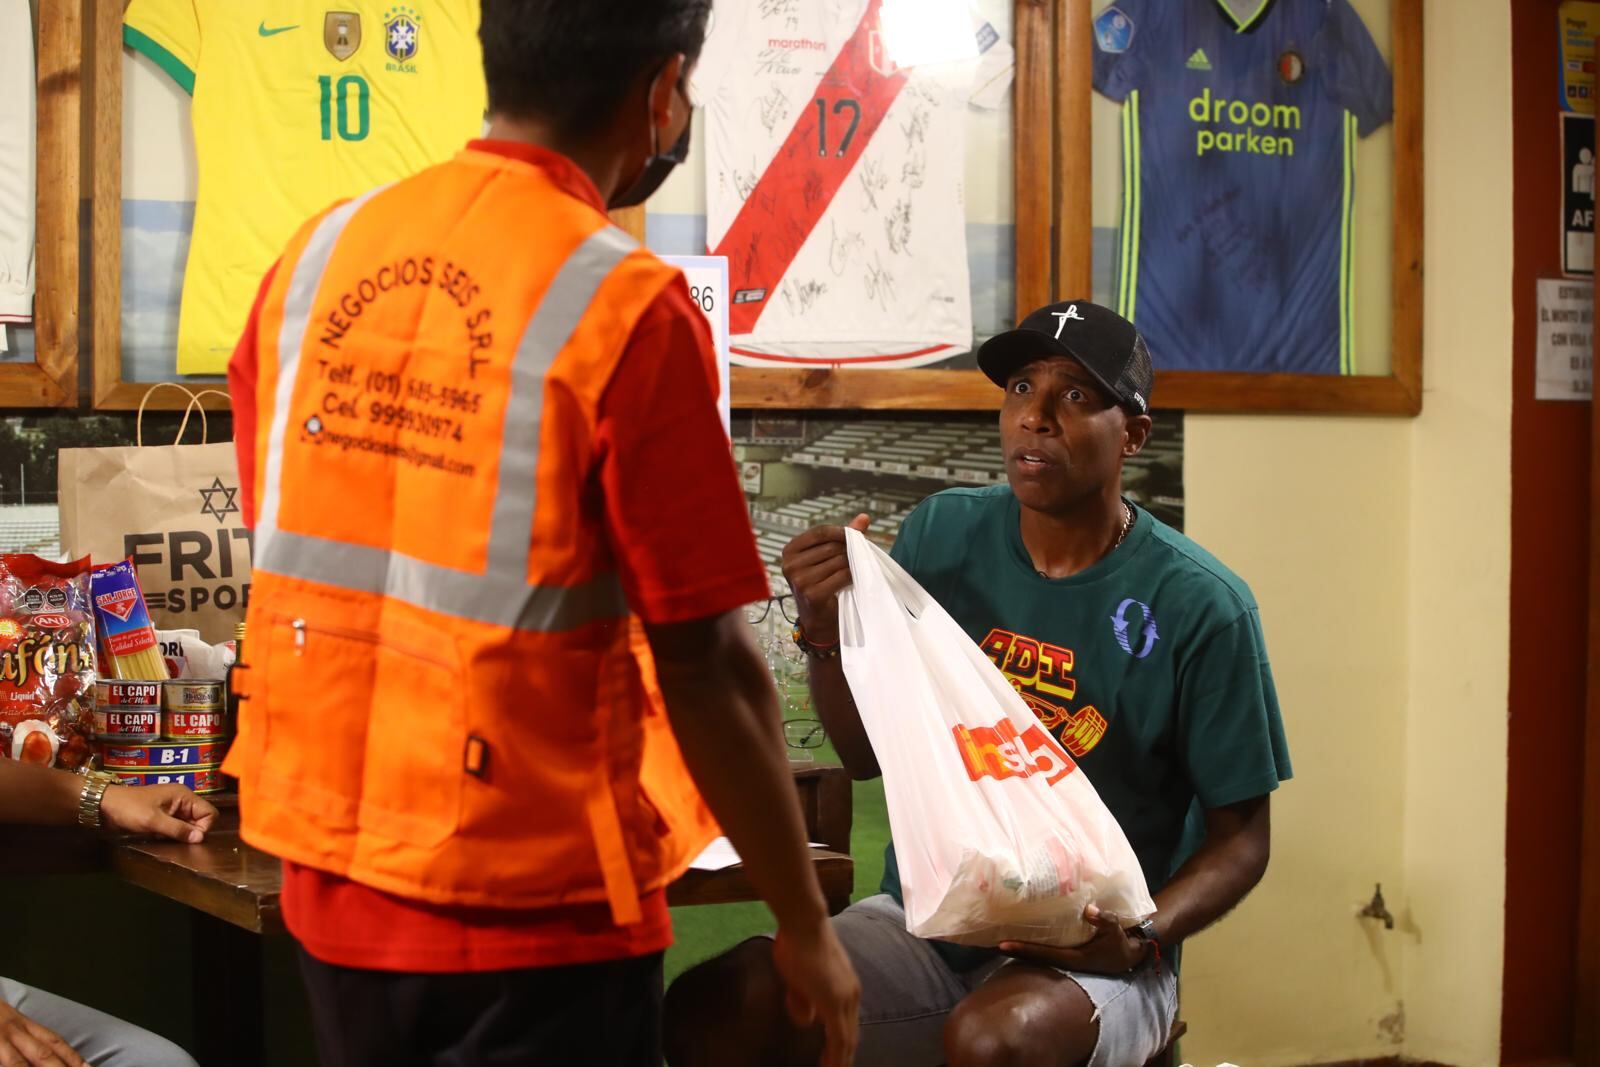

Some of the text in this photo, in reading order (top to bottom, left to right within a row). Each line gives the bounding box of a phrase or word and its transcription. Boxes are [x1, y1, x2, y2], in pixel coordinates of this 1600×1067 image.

[768, 38, 826, 51] marathon
[385, 63, 417, 73] BRASIL
[318, 75, 370, 141] 10
[1188, 87, 1301, 129] droom
[815, 98, 862, 158] 17
[1197, 127, 1294, 156] parken
[320, 257, 433, 349] NEGOCIOS
[439, 262, 480, 308] SEIS
[96, 587, 137, 605] SAN JORGE
[38, 617, 65, 625] ANI
[10, 691, 35, 703] Liquid
[112, 685, 155, 697] EL CAPO
[110, 714, 153, 725] EL CAPO
[174, 714, 220, 727] EL CAPO
[161, 748, 189, 764] B-1
